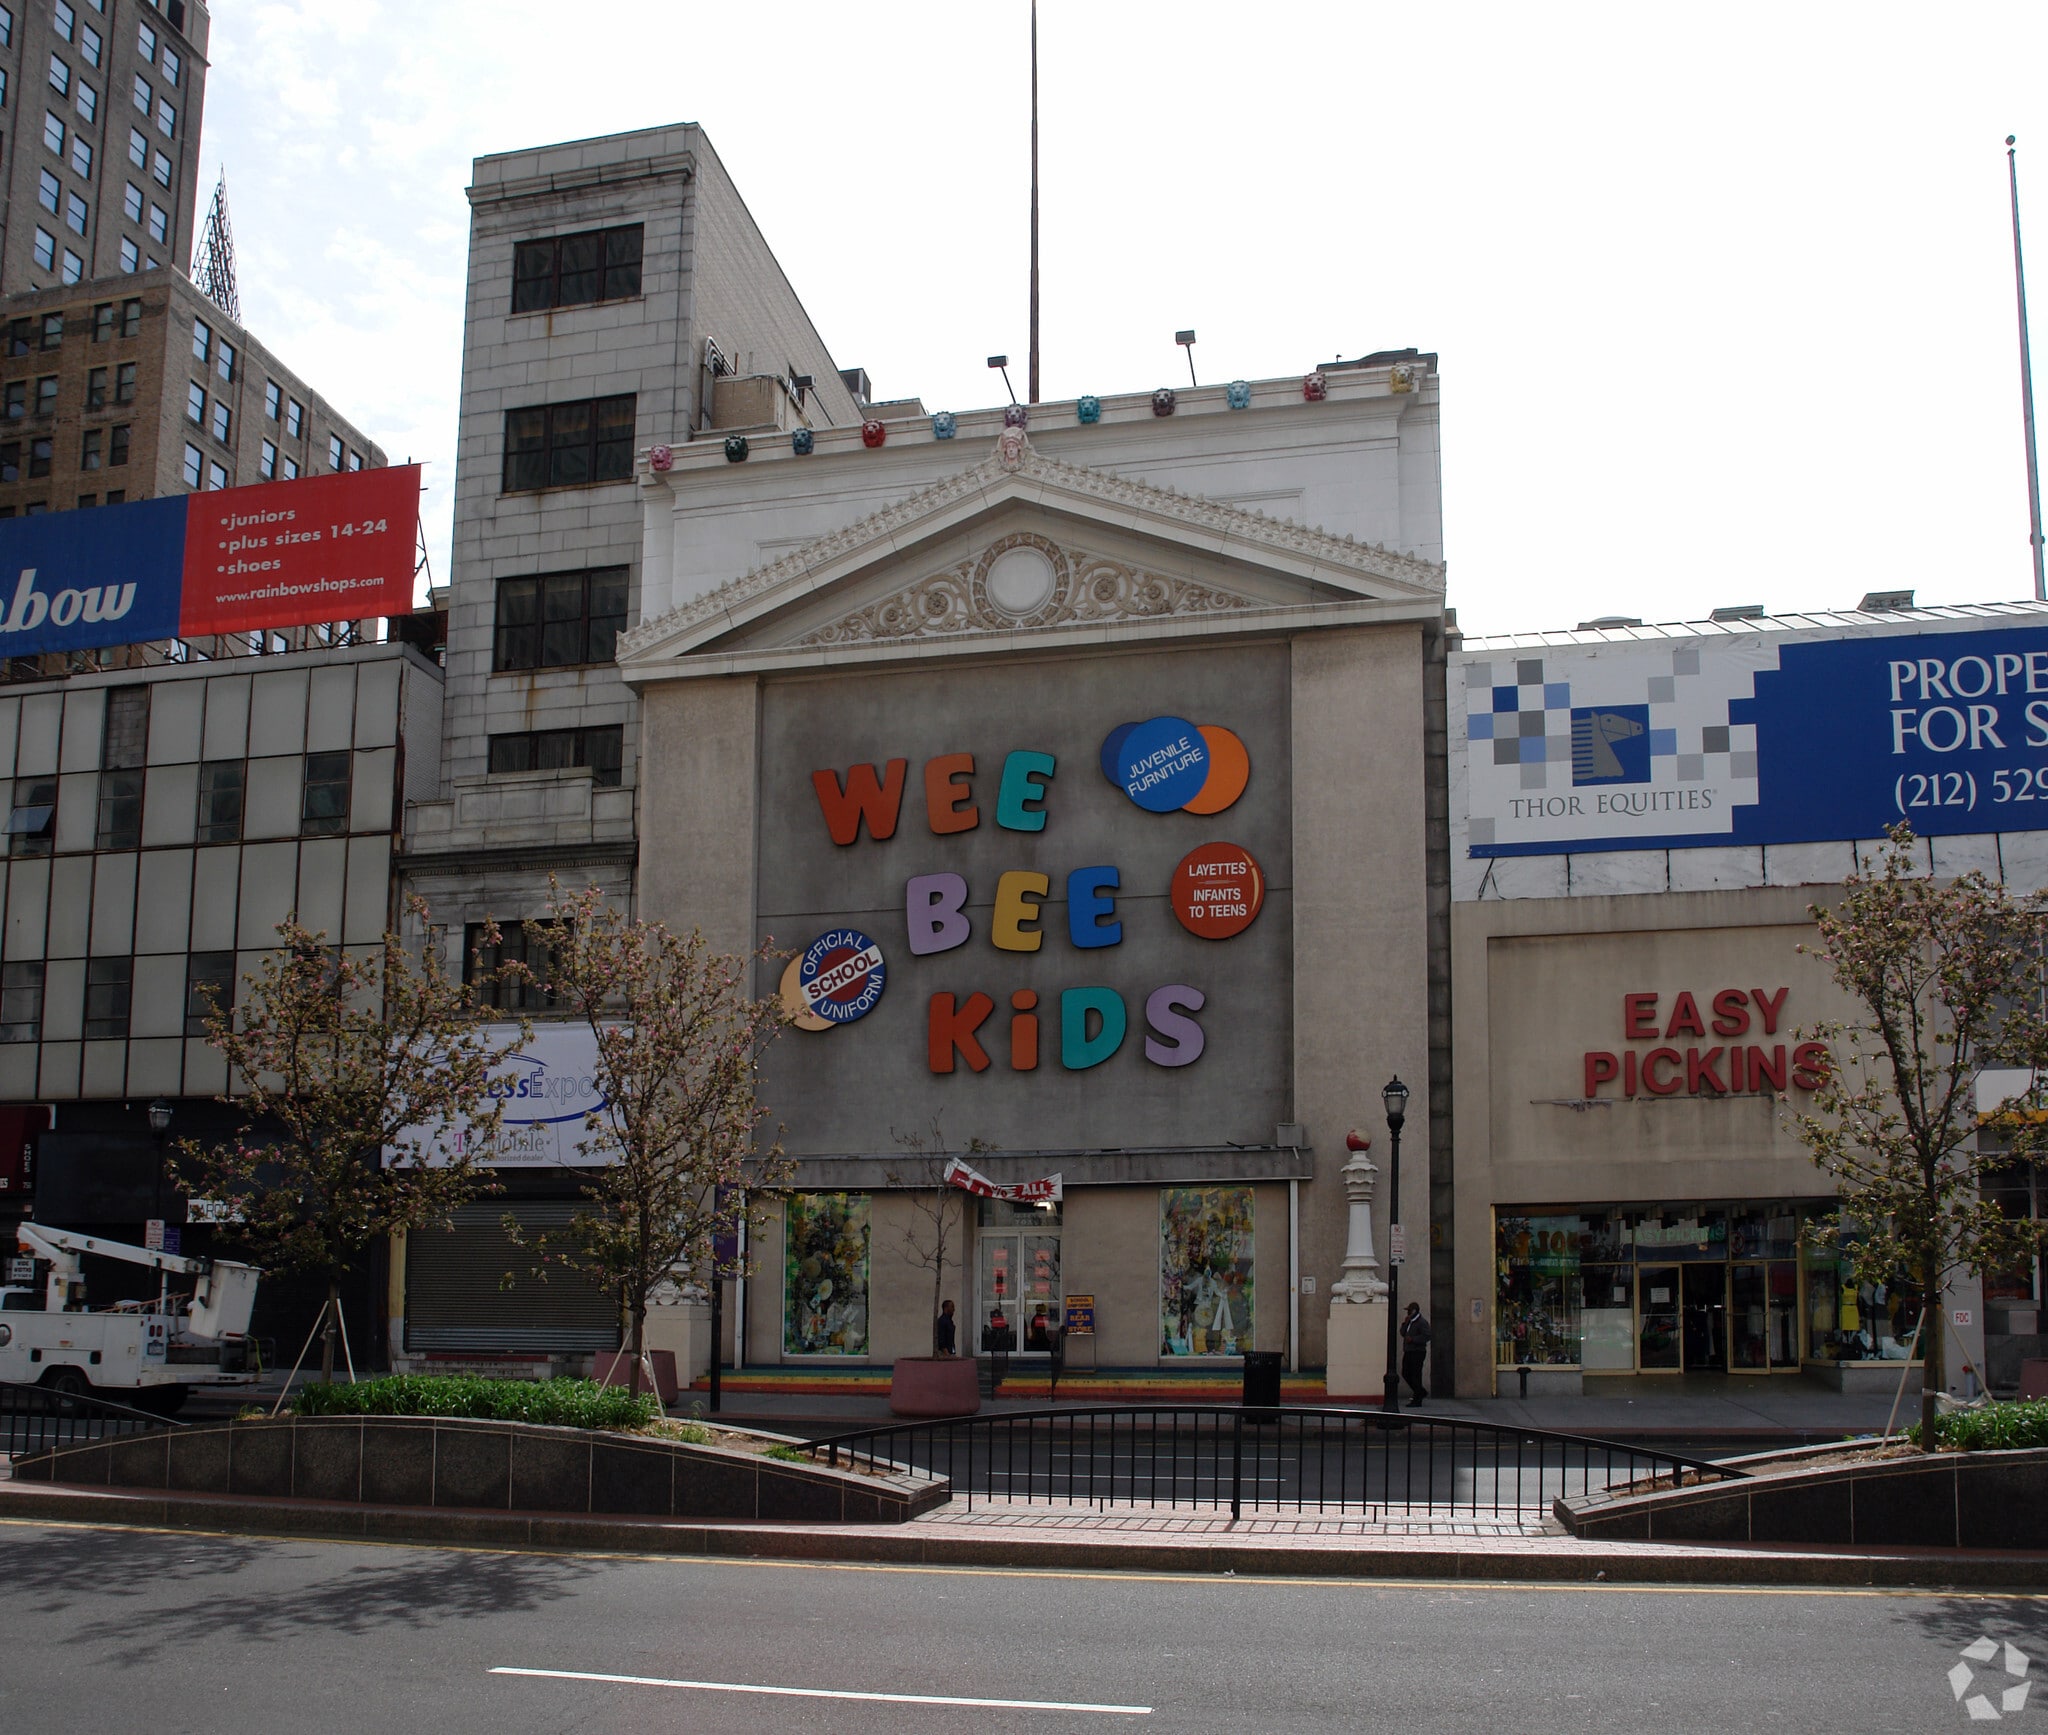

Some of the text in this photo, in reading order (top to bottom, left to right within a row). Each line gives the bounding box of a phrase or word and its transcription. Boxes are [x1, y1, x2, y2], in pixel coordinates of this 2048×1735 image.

[228, 508, 296, 531] juniors
[229, 518, 388, 554] plus sizes 14-24
[227, 556, 281, 575] shoes
[0, 568, 137, 634] bow
[215, 576, 384, 604] www.rainbowshops.com
[1889, 651, 2048, 702] PROPE
[1890, 703, 2008, 755] FOR
[1127, 748, 1204, 797] FURNITURE
[1129, 737, 1191, 779] JUVENILE
[812, 750, 1056, 846] WEE
[1508, 795, 1586, 819] THOR
[1895, 770, 1977, 814] (212)
[1188, 862, 1247, 878] LAYETTES
[905, 865, 1122, 956] BEE
[1188, 903, 1247, 919] TO TEENS
[1193, 888, 1242, 902] INFANTS
[802, 931, 864, 977] OFFICIAL
[806, 950, 880, 1001] SCHOOL
[819, 973, 884, 1020] UNIFORM
[1624, 987, 1790, 1040] EASY
[1583, 1042, 1832, 1099] PICKINS
[1021, 1183, 1048, 1197] ALL
